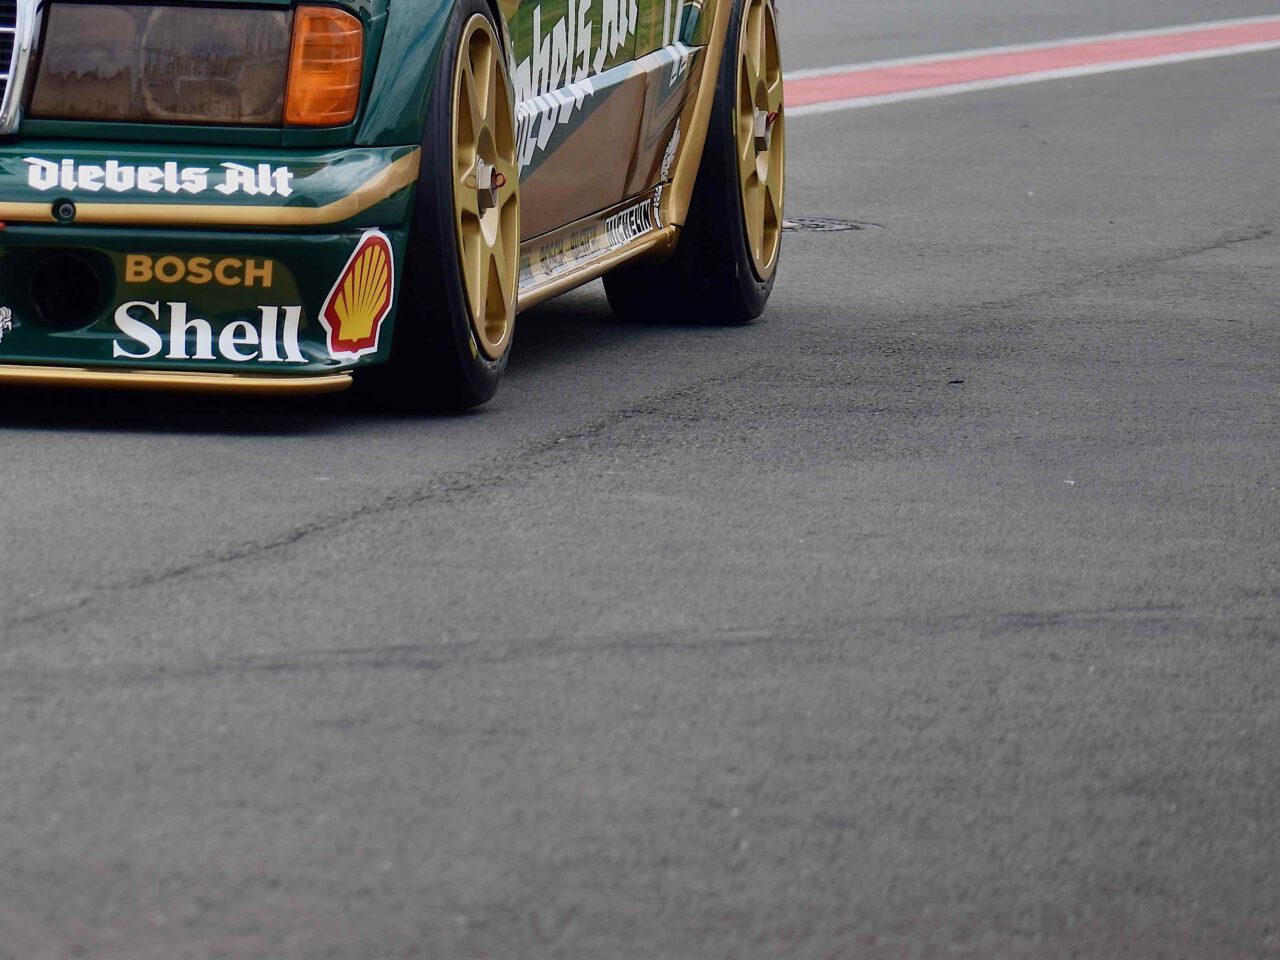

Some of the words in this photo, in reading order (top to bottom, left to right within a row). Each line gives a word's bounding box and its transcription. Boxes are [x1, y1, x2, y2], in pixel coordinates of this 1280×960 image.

[22, 157, 210, 194] Diebels
[214, 162, 294, 198] Alt
[604, 198, 654, 248] MICHELIN
[124, 254, 274, 288] BOSCH
[112, 300, 309, 363] Shell
